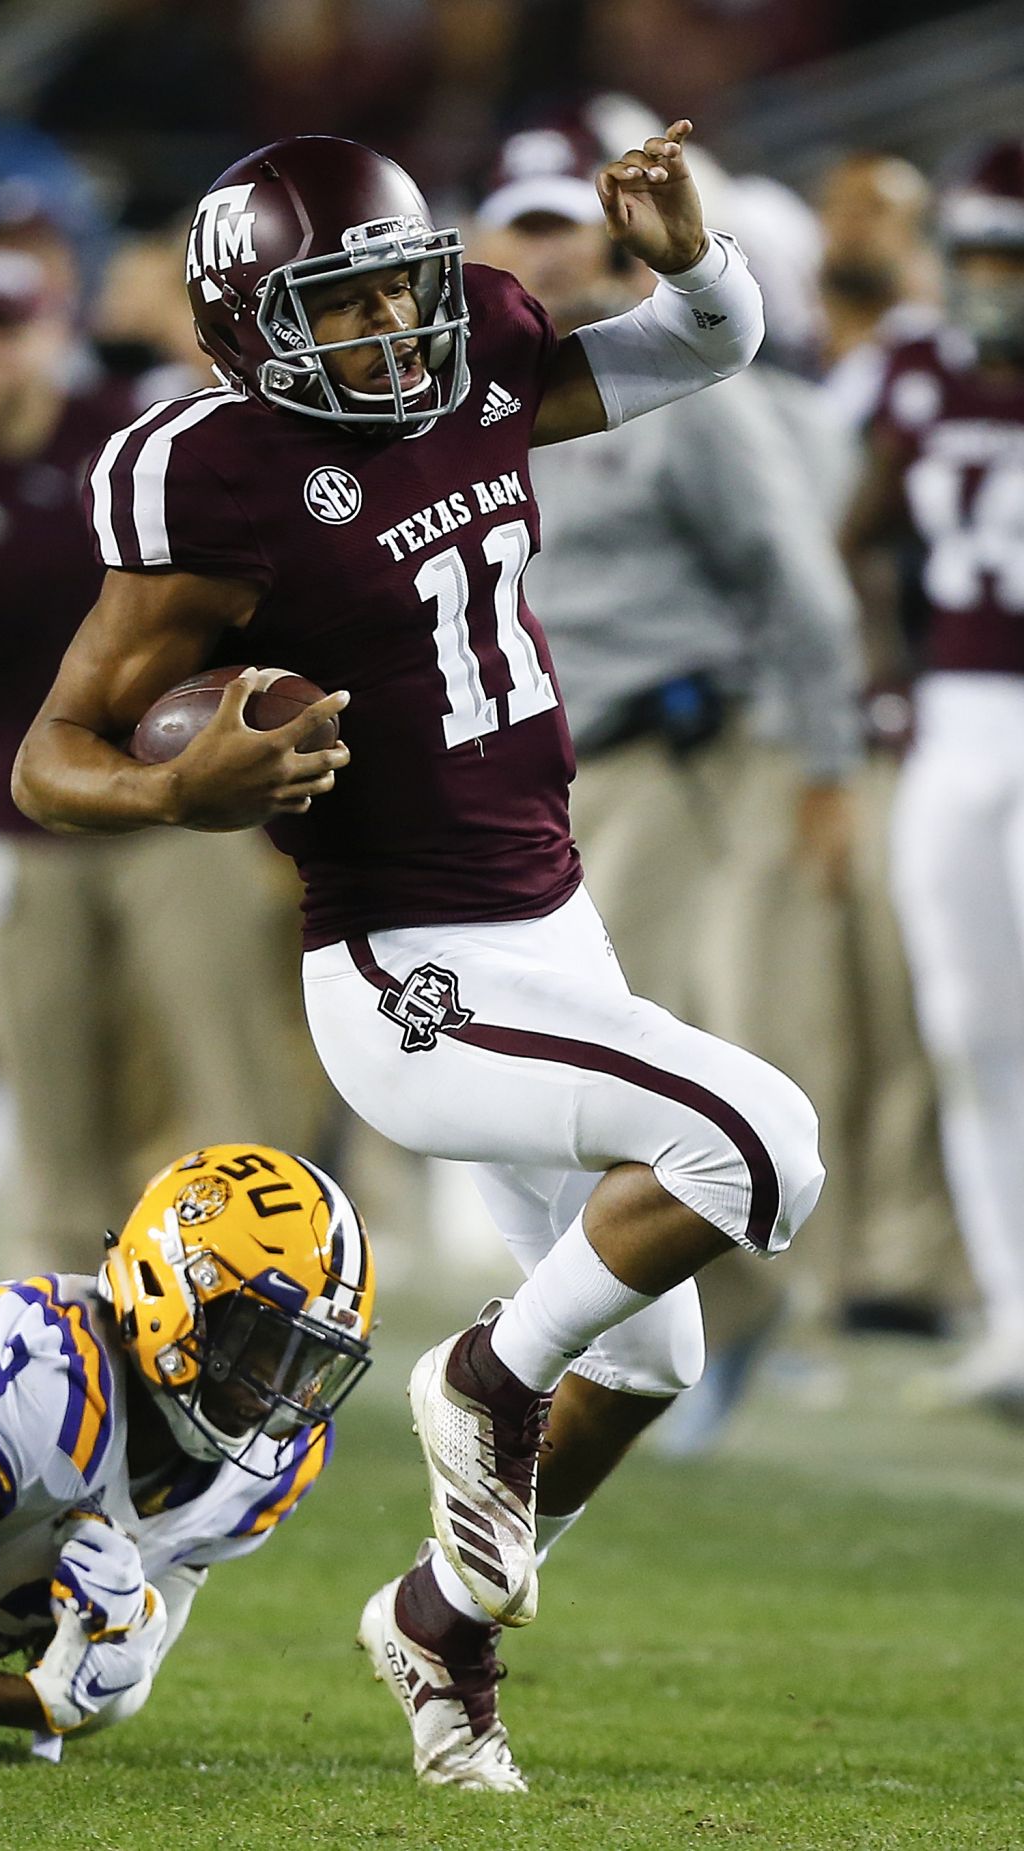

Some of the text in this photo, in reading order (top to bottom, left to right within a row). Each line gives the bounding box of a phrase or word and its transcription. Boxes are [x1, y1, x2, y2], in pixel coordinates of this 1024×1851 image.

[479, 397, 522, 427] adidas
[308, 470, 358, 520] SEC
[376, 470, 528, 562] TEXAS A&M
[413, 518, 559, 750] 11
